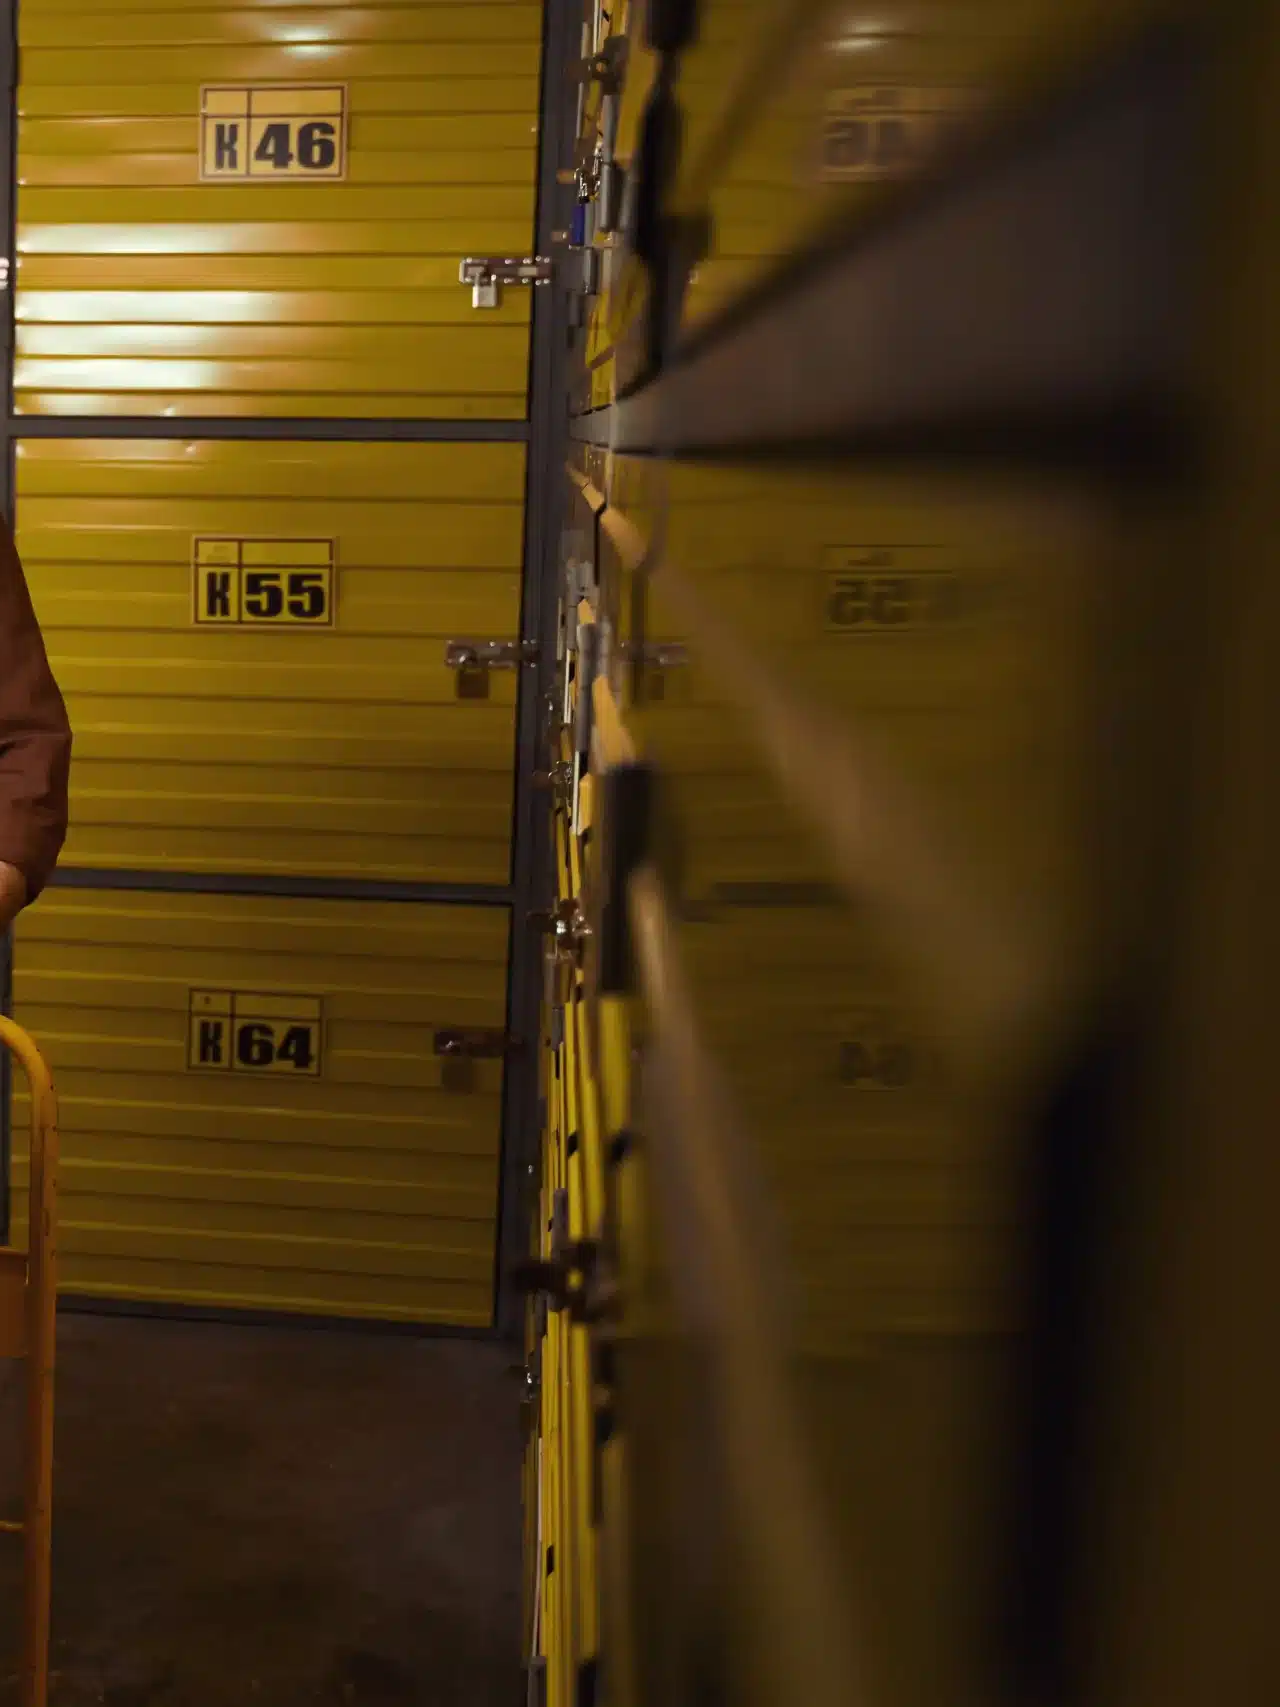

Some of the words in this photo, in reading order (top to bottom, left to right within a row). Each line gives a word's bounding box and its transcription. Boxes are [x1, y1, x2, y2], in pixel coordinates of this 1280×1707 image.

[215, 123, 239, 169] K
[254, 122, 336, 169] 46
[207, 572, 230, 616] K
[245, 573, 325, 619] 55
[200, 1021, 223, 1063] K
[237, 1023, 314, 1069] 64
